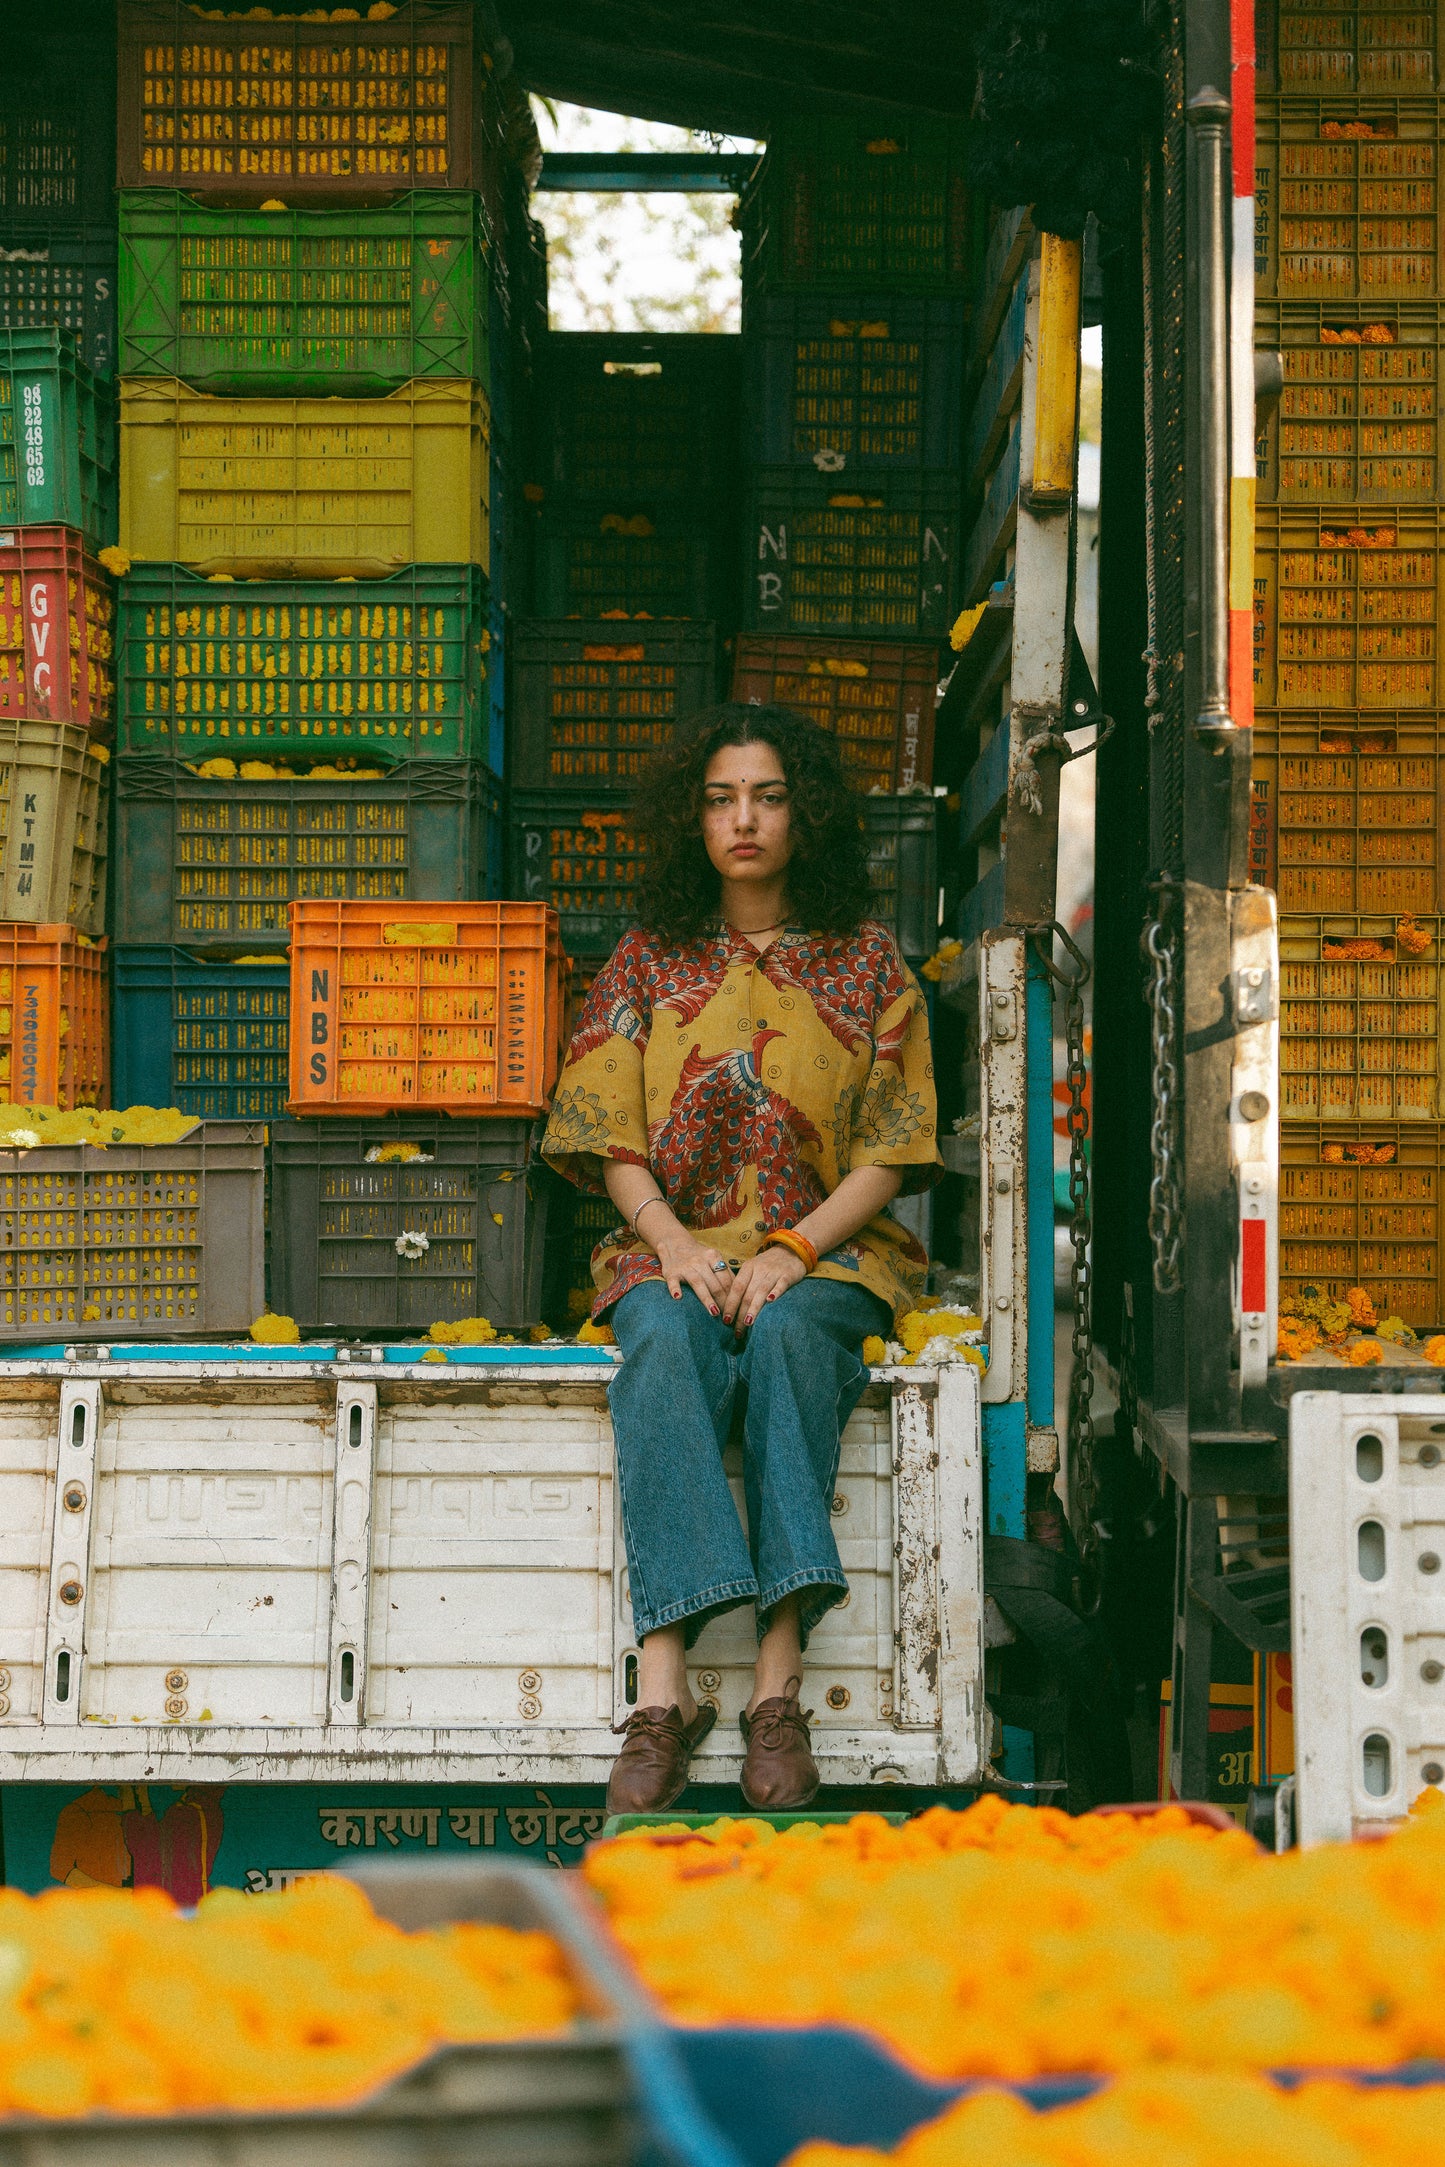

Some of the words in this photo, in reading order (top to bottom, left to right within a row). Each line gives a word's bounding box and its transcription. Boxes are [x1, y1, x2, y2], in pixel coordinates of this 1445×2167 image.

[30, 583, 51, 698] GVC
[21, 985, 39, 1101] 7349460441
[310, 969, 329, 1086] NBS
[319, 1807, 442, 1847] कारण
[448, 1807, 499, 1847] या
